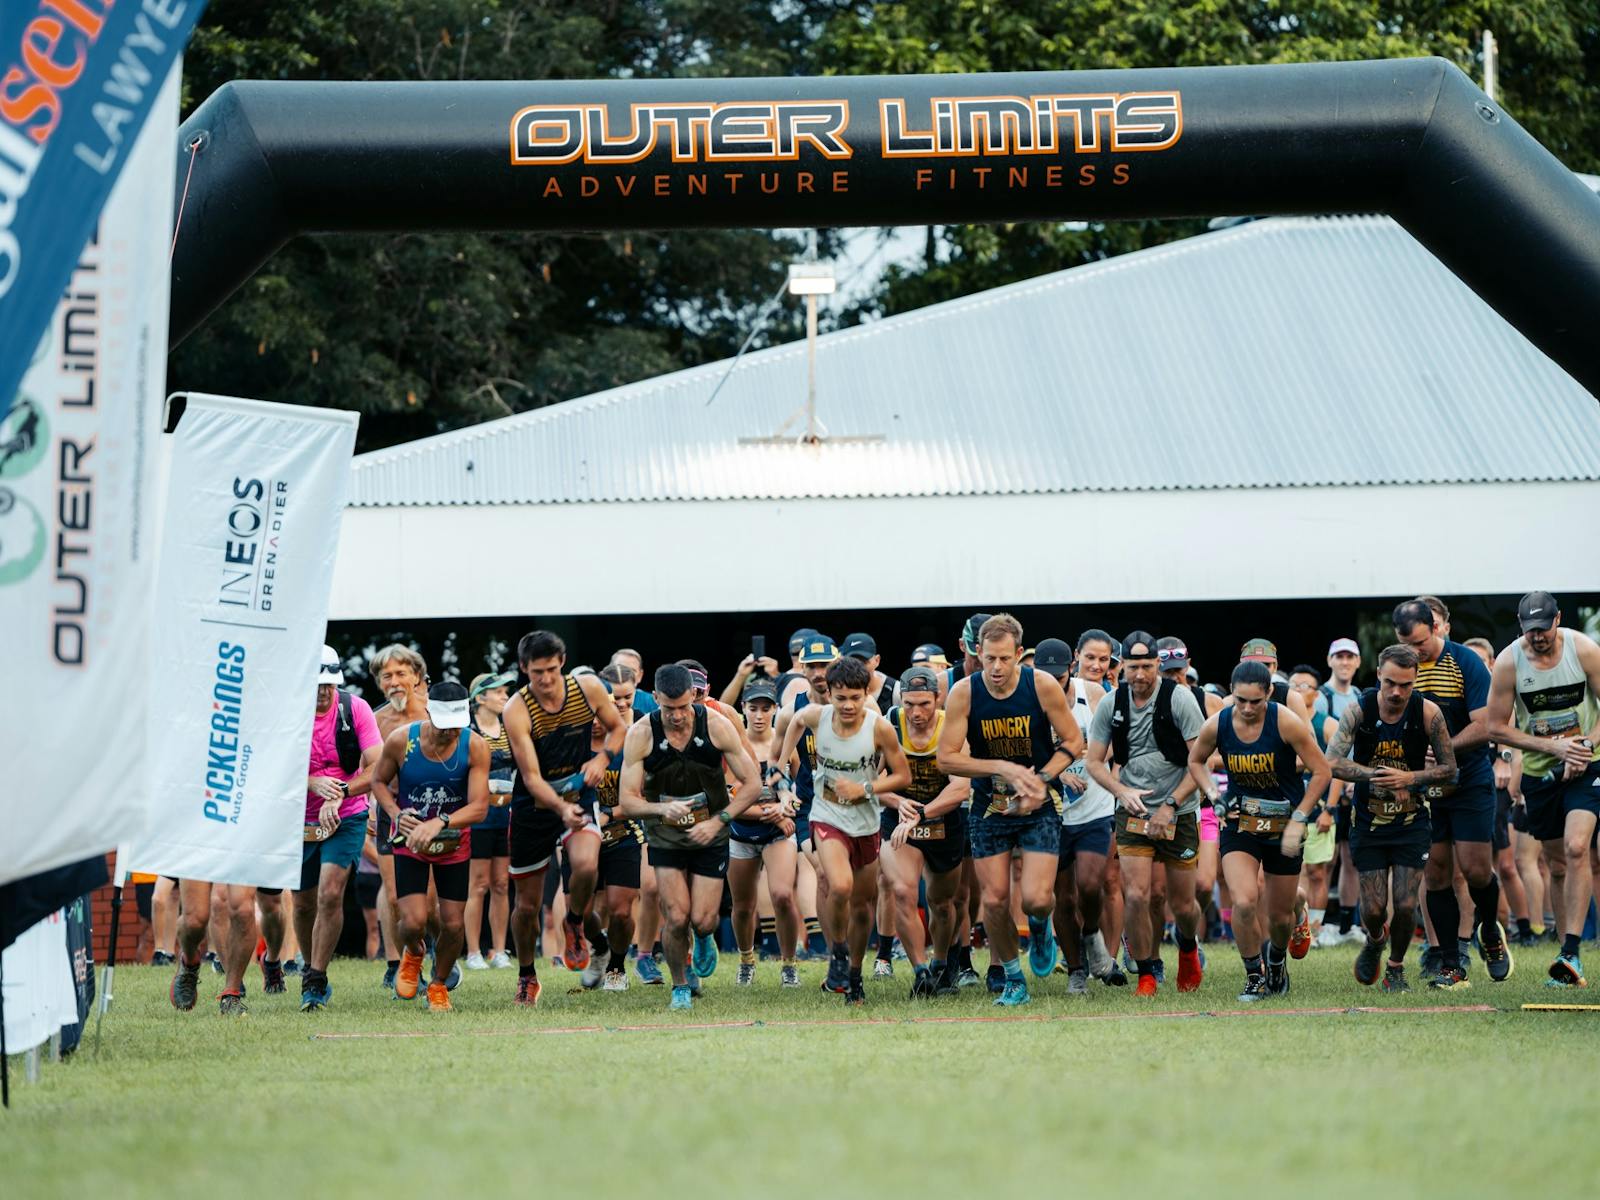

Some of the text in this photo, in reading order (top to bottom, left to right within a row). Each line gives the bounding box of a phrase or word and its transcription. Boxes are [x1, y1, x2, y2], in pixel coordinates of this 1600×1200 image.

[511, 99, 852, 165] OUTER
[543, 164, 1130, 198] ADVENTURE FITNESS
[52, 436, 96, 667] OUTER
[219, 476, 264, 608] INEOS
[981, 715, 1031, 740] HUNGRY
[1228, 752, 1275, 774] HUNGRY
[230, 744, 253, 825] Auto Group
[1428, 787, 1443, 797] 65
[677, 813, 695, 825] 05
[1256, 820, 1271, 831] 24
[912, 827, 931, 838] 128
[428, 842, 444, 854] 49
